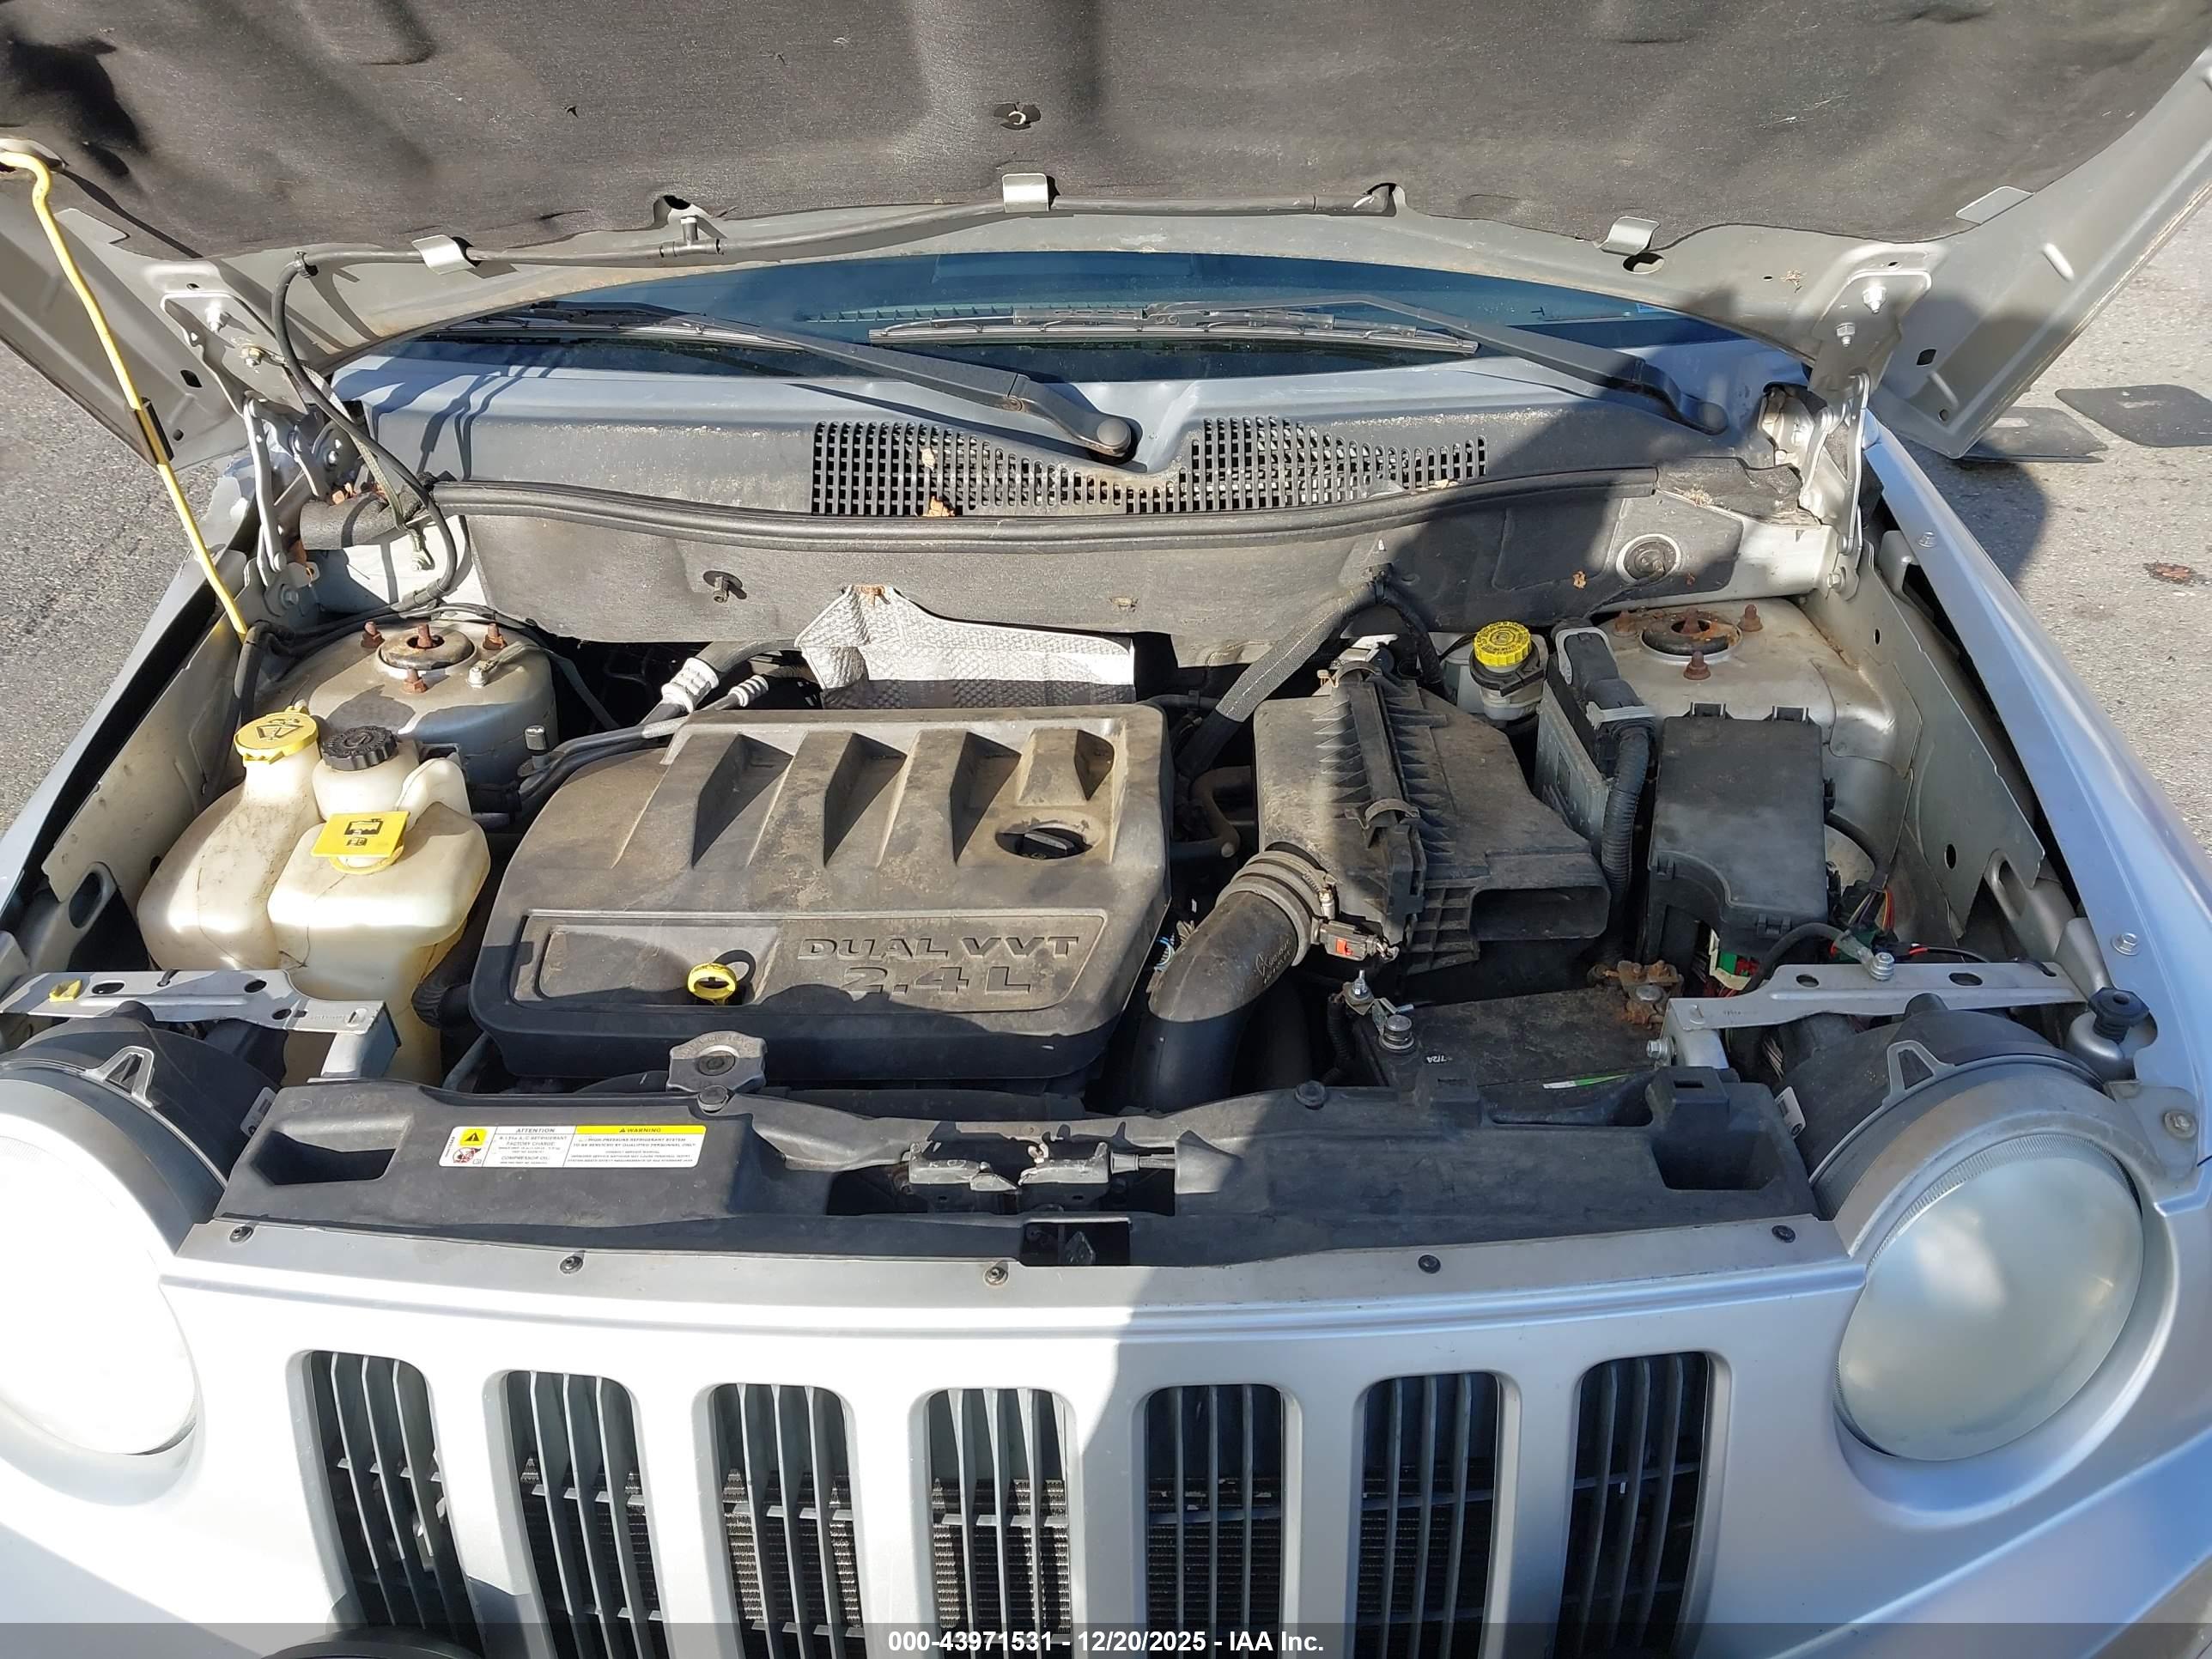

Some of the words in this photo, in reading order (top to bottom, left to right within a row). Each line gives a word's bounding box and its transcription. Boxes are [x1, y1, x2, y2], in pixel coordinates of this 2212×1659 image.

[798, 938, 949, 961] DUAL
[962, 936, 1079, 959] VVT
[840, 966, 1031, 995] 2.4L
